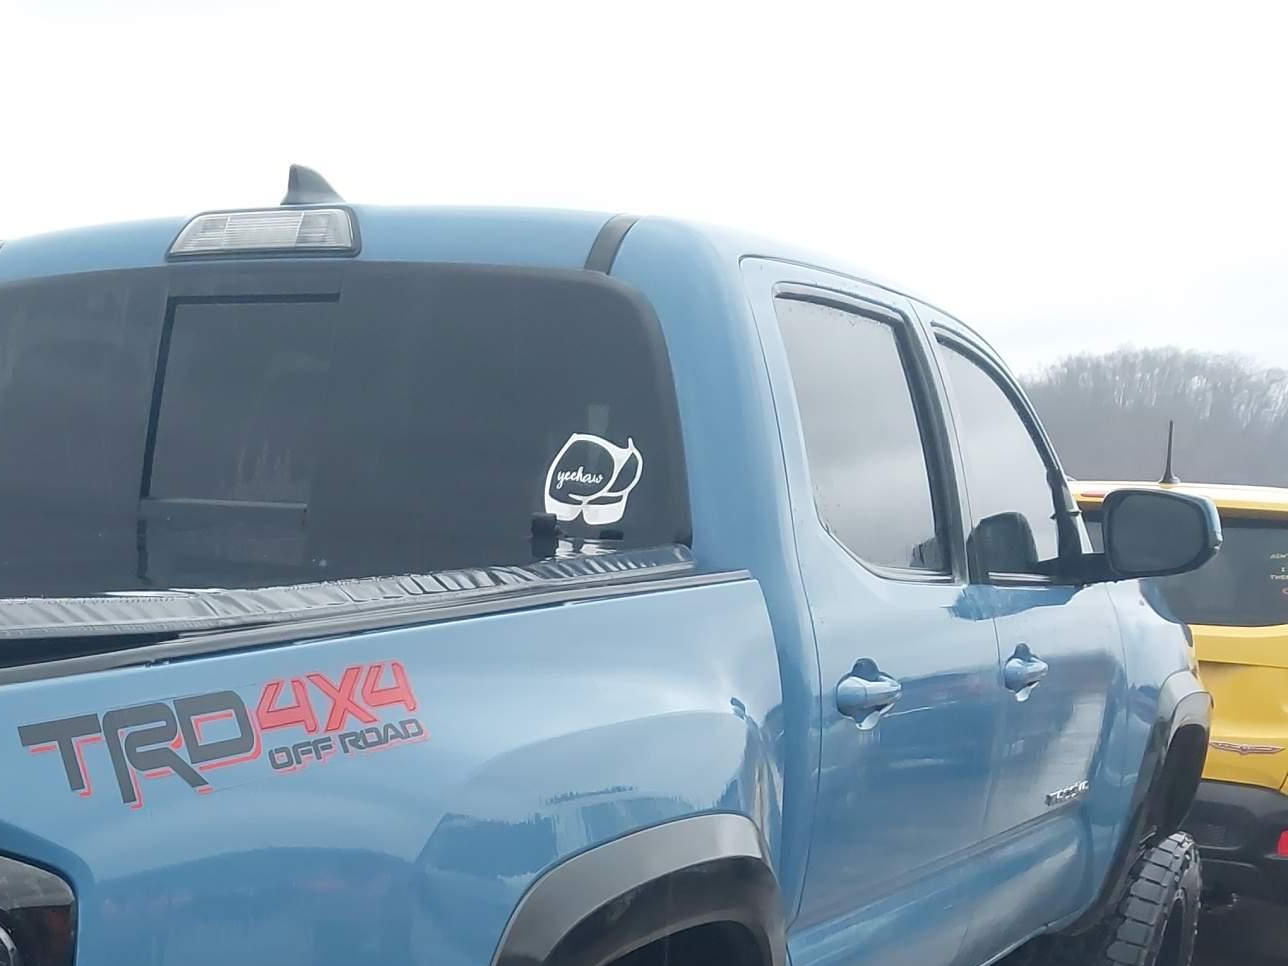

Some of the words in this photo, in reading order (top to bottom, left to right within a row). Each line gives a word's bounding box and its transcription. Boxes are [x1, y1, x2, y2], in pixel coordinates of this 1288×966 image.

[556, 466, 603, 489] yeehaw
[17, 690, 262, 809] TRD
[255, 660, 418, 734] 4X4
[268, 734, 336, 773] OFF
[340, 718, 430, 756] ROAD
